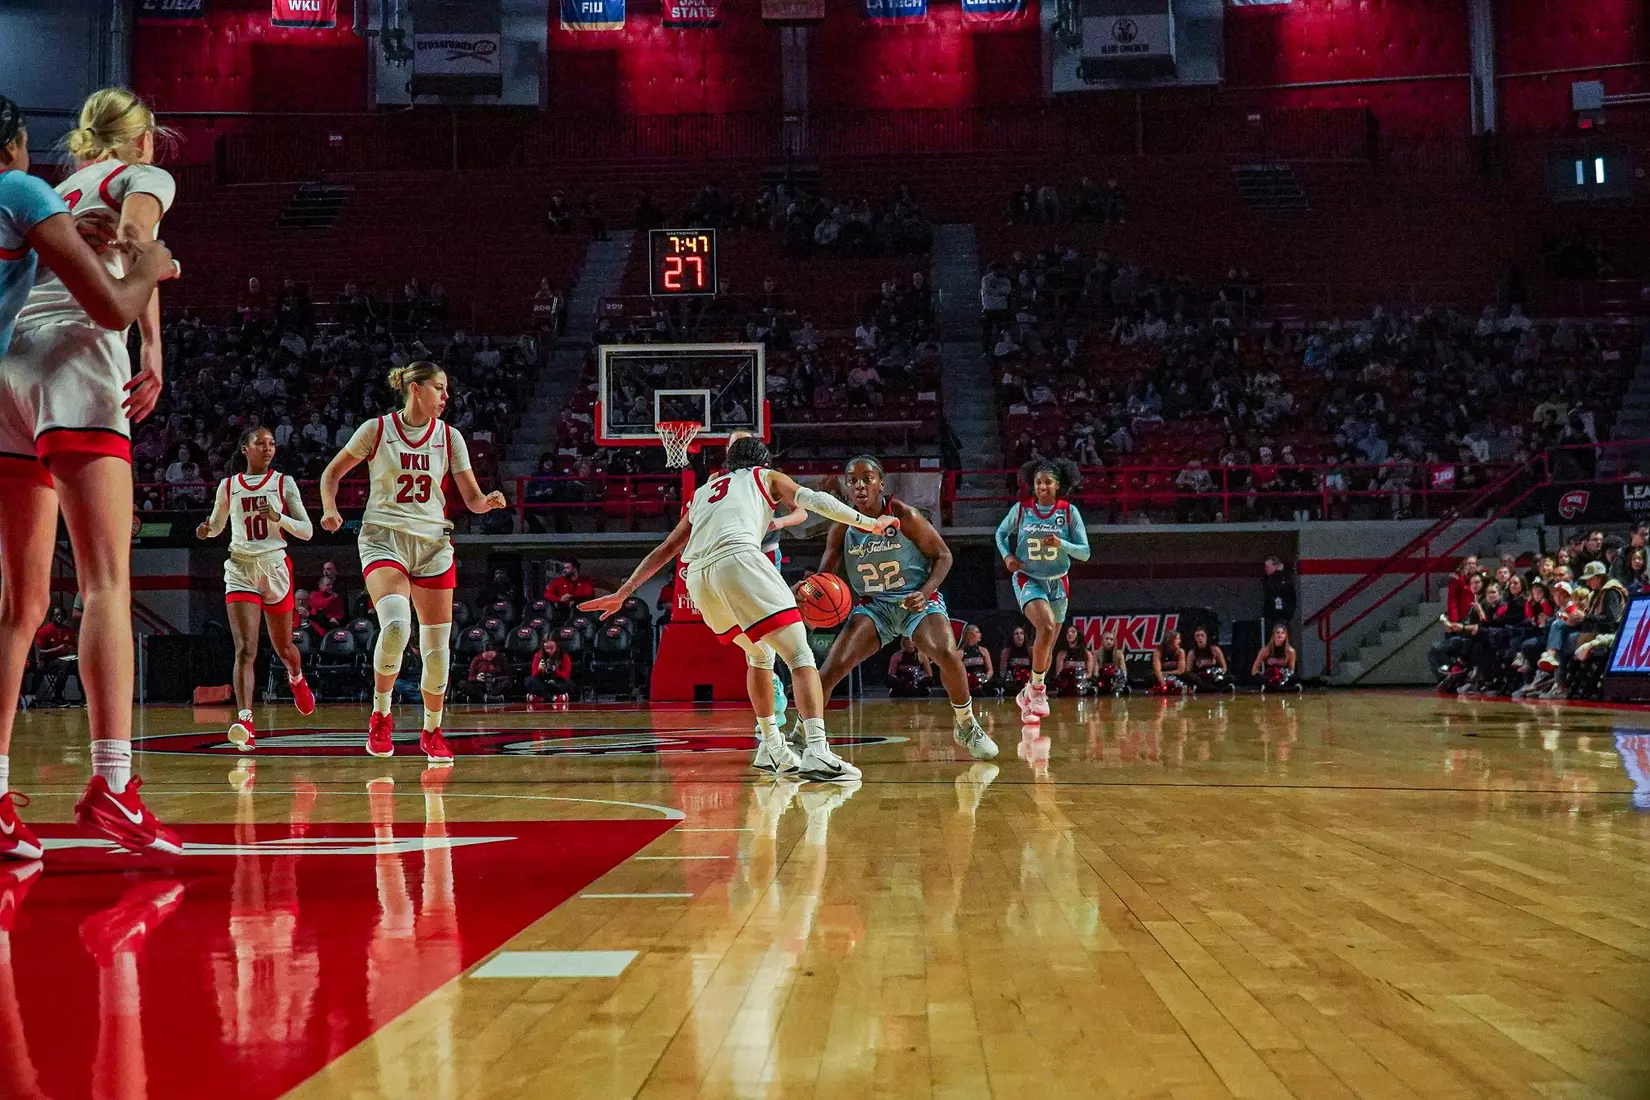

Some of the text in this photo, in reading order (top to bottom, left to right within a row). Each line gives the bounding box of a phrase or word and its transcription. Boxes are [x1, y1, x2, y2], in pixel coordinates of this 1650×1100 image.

[288, 0, 320, 11] WKU
[581, 2, 603, 13] FIU
[671, 7, 715, 18] STATE
[670, 236, 708, 252] 7:47
[665, 256, 702, 288] 27
[400, 452, 430, 471] WKU
[396, 474, 432, 503] 23
[707, 477, 732, 504] 3
[244, 515, 269, 541] 10
[857, 561, 907, 593] 22
[1073, 614, 1180, 653] WKU
